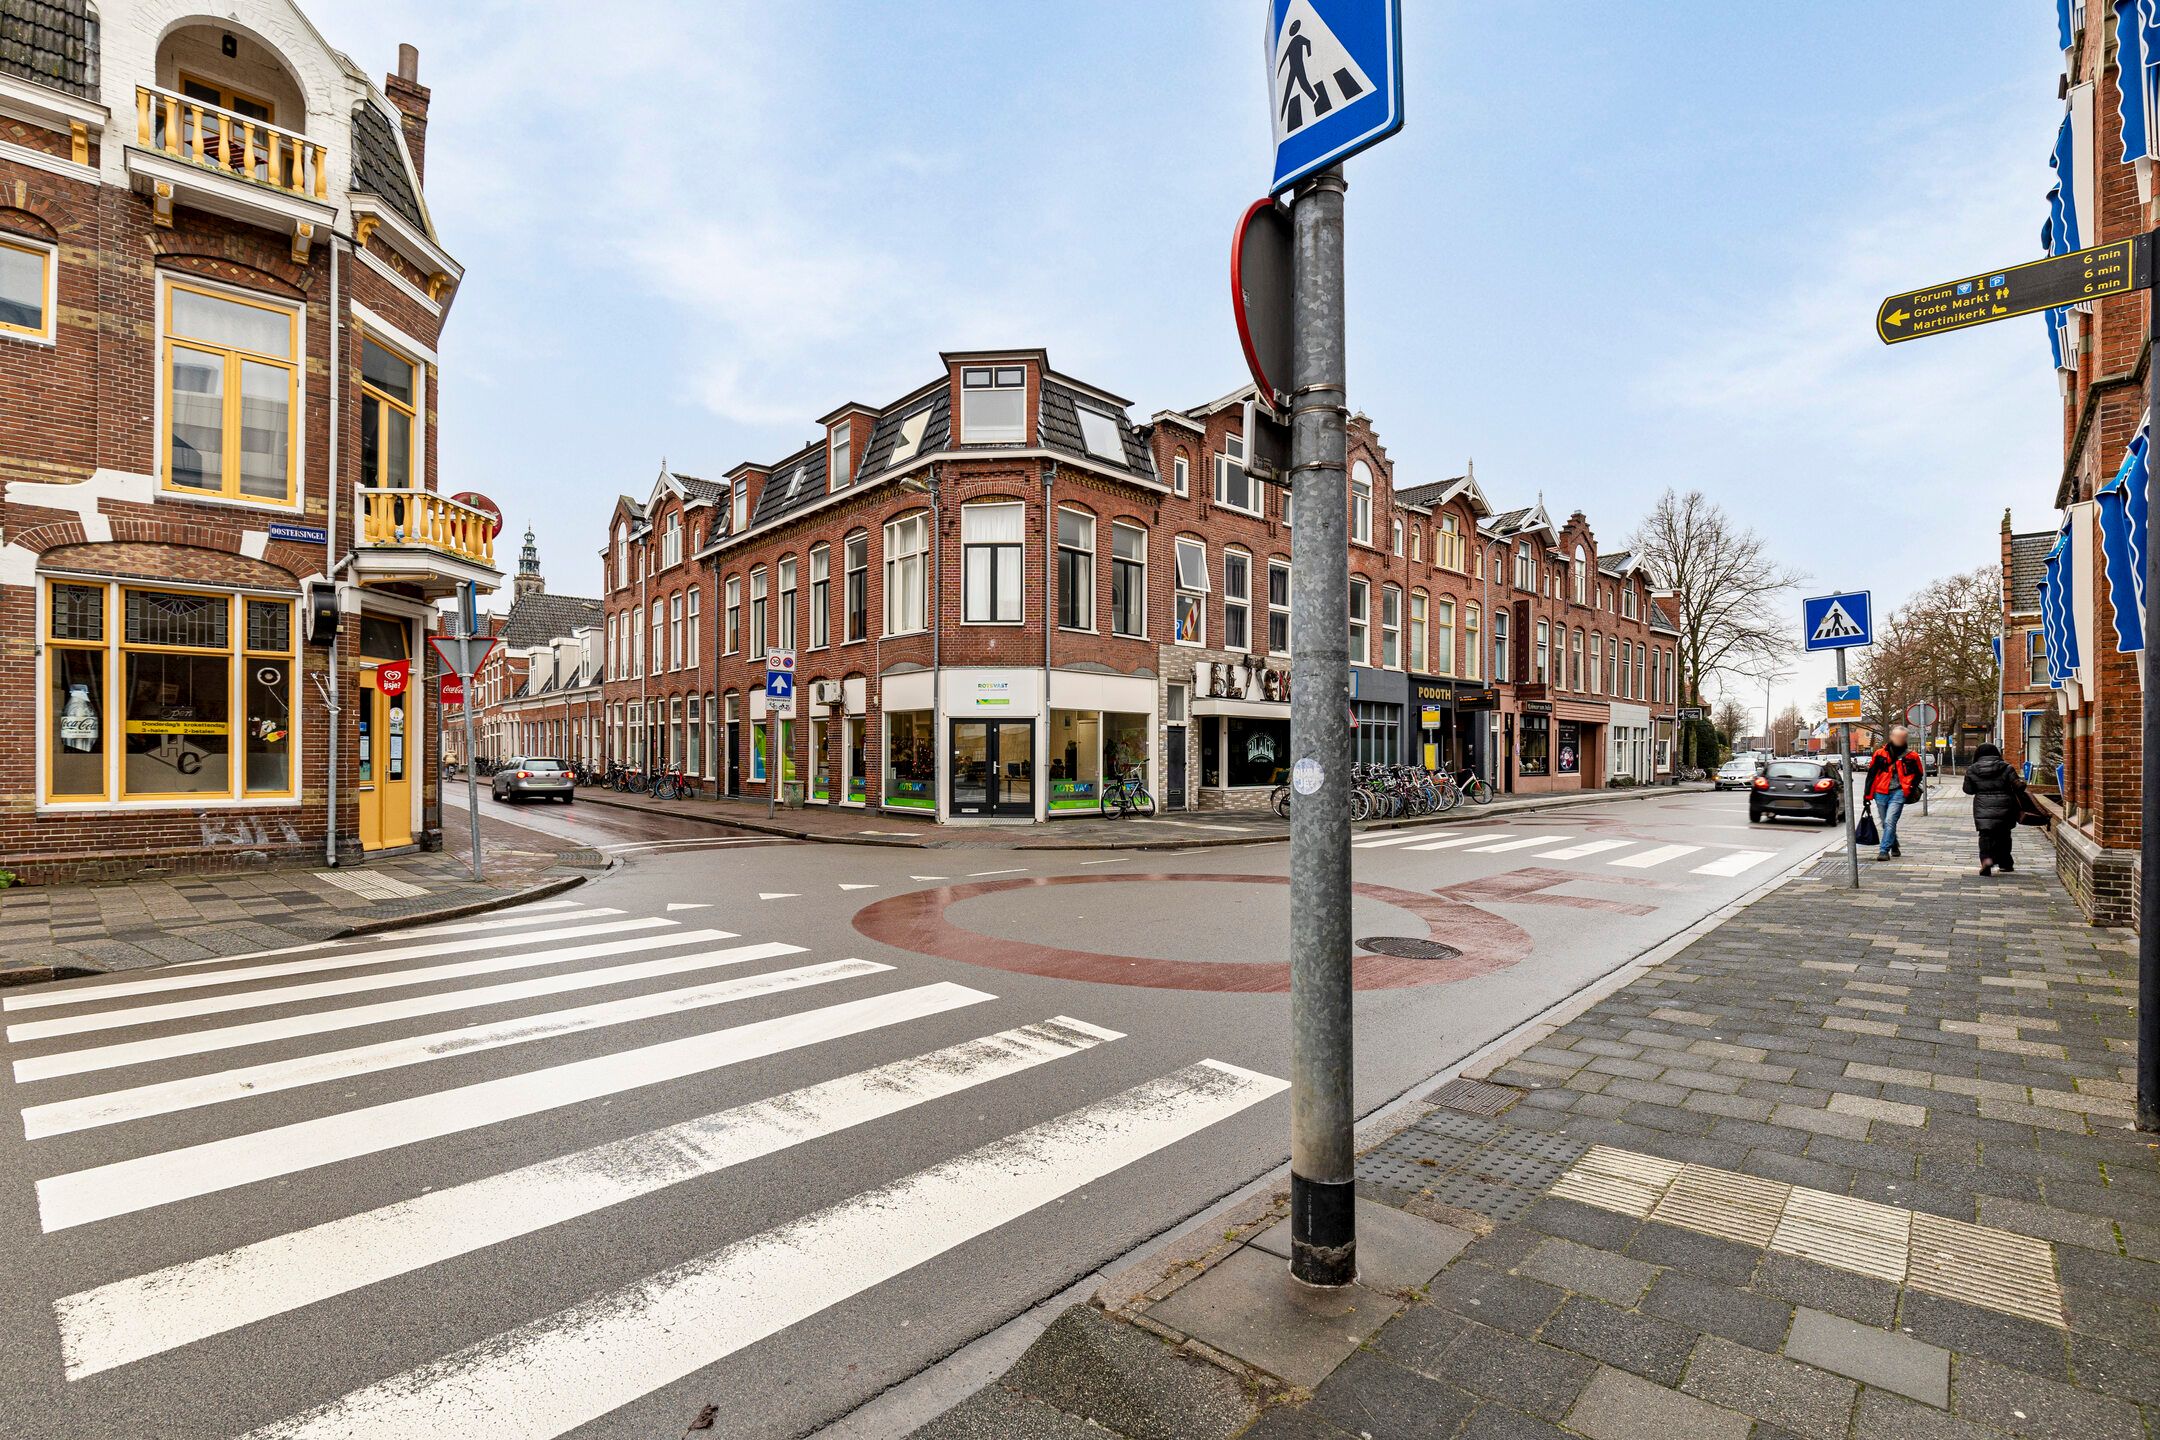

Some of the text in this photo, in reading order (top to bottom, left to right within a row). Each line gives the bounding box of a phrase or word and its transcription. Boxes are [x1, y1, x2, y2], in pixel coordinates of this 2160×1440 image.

[1914, 289, 1952, 304] Forum
[2083, 254, 2093, 264] 6
[2098, 250, 2121, 261] min
[1914, 265, 2121, 318] Grote Markt 6 min
[1913, 279, 2120, 331] Martinikerk 6 min
[271, 527, 325, 540] OOSTERSINGEL
[384, 680, 401, 690] ijsje?
[1418, 687, 1451, 700] PODOTH
